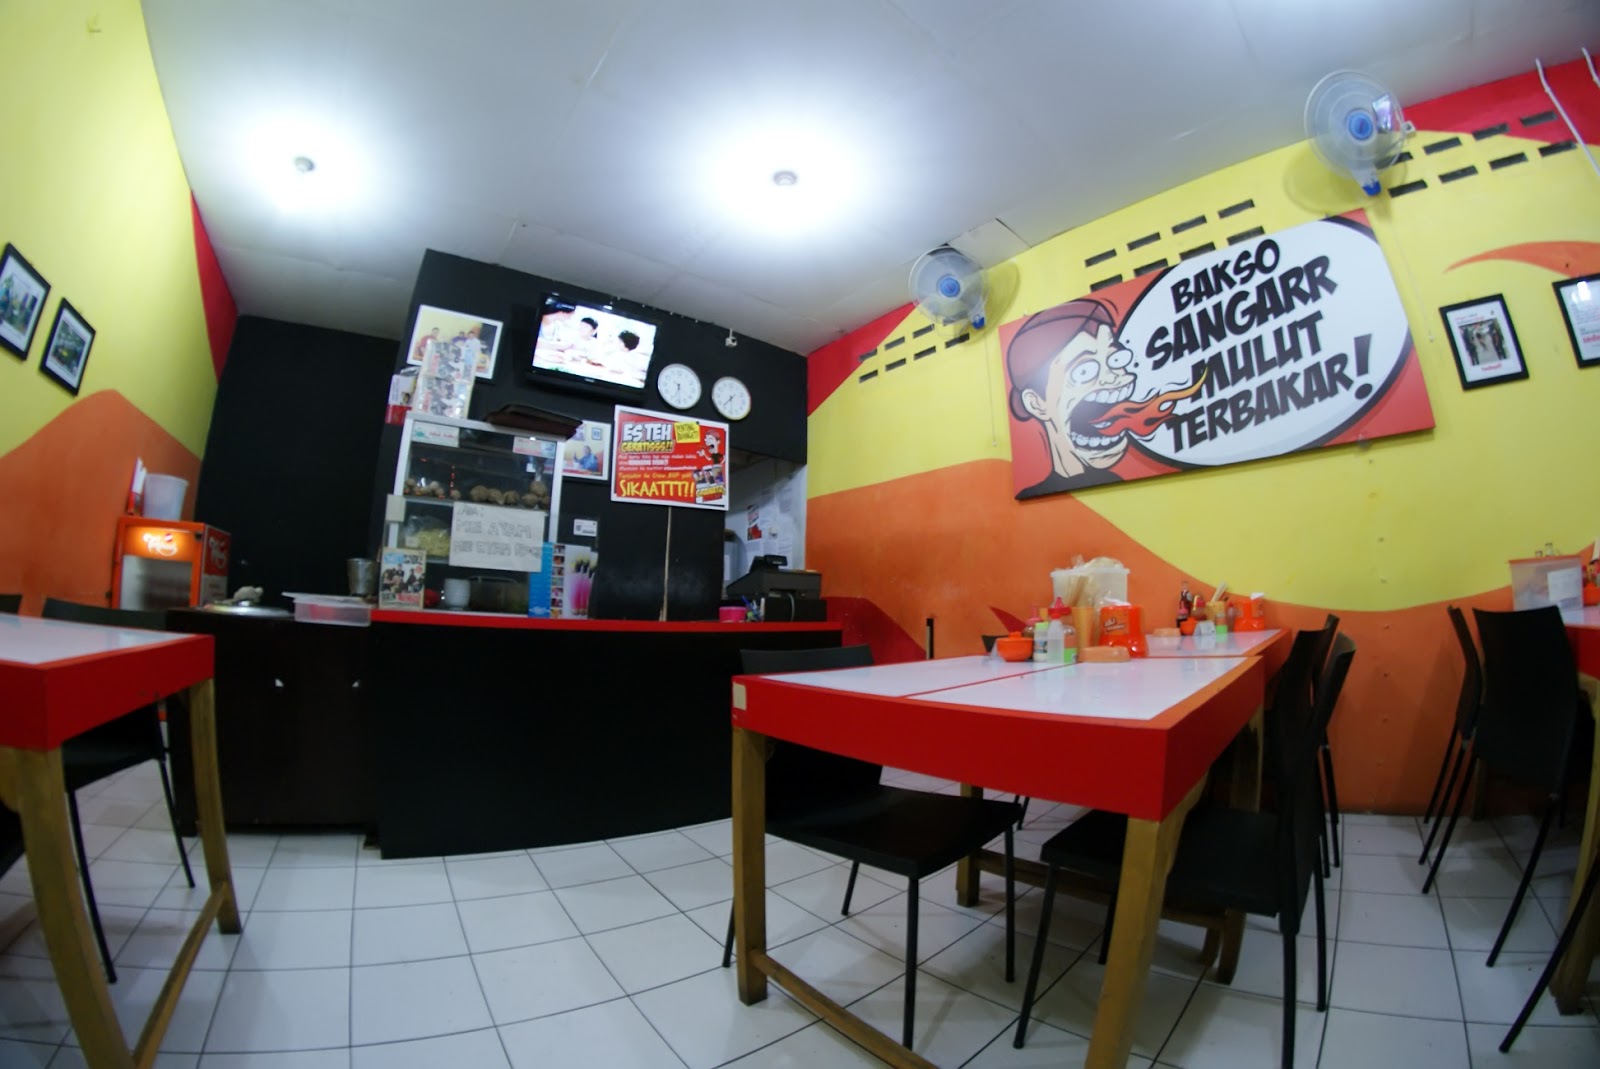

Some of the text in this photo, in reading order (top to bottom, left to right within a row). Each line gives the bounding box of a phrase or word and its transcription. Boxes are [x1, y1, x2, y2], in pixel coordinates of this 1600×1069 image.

[1145, 255, 1338, 371] SANGARR
[1170, 238, 1280, 314] BAKSO
[1164, 333, 1373, 453] TERBAKAR!
[1190, 310, 1323, 403] MULUT
[622, 423, 643, 441] ES
[644, 423, 673, 441] TEH
